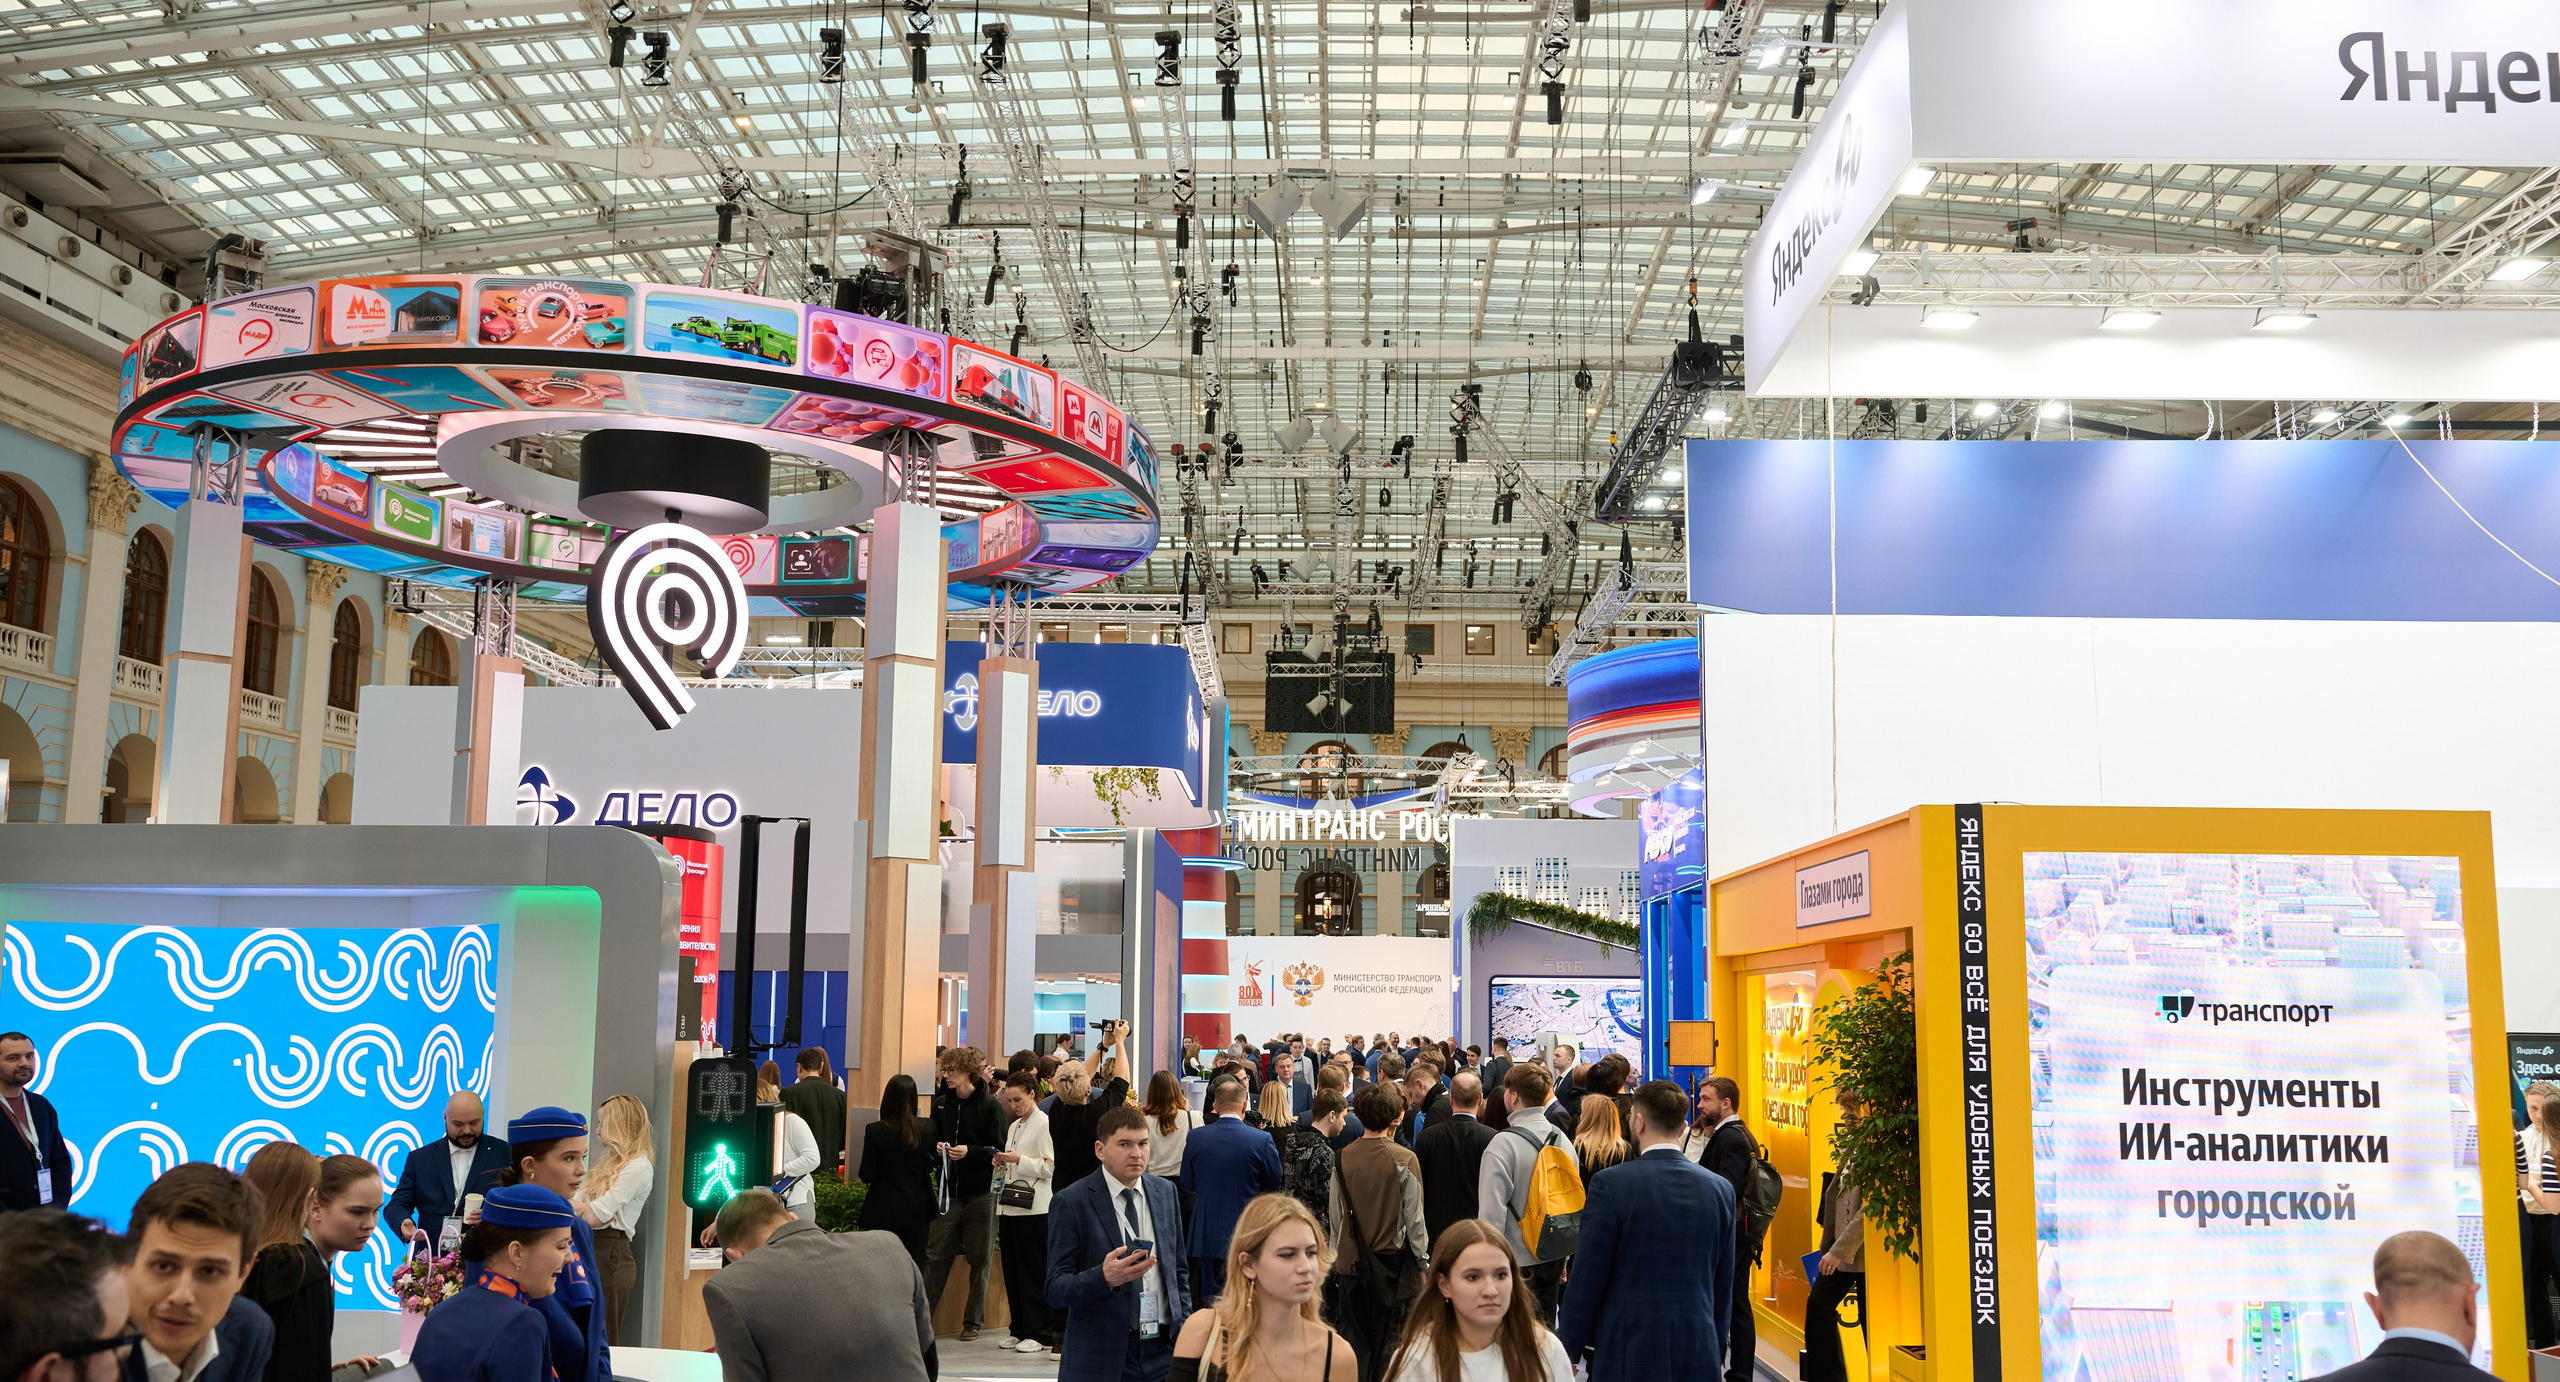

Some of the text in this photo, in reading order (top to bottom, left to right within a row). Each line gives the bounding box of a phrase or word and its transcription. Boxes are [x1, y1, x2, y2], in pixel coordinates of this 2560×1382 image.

[2338, 32, 2560, 113] Янде
[1772, 112, 1863, 307] Яндекс Go
[248, 301, 296, 314] Московская
[520, 281, 587, 311] Транспорта
[243, 330, 268, 340] МАДИ
[550, 312, 589, 348] Москвы
[1037, 691, 1101, 717] ЕЛО
[594, 792, 738, 827] ДЕЛО
[1238, 809, 1386, 842] МИНТРАНС
[1801, 872, 1863, 909] Глазами города
[680, 924, 701, 933] шения
[679, 941, 716, 951] авительства
[708, 973, 716, 984] РФ
[1333, 973, 1442, 983] МИНИСТЕРСТВО ТРАНСПОРТА
[1556, 960, 1583, 973] ВТБ
[1238, 985, 1251, 999] 80
[1333, 984, 1434, 995] РОССИЙСКОЙ ФЕДЕРАЦИИ
[1762, 1000, 1790, 1035] Яндекс
[2199, 1003, 2333, 1027] транспорт
[2516, 1046, 2554, 1056] Яндекс Go
[1788, 1054, 1807, 1092] удоб
[1960, 818, 1996, 1325] ЯНДЕКС GO ВСЁ ДЛЯ УДОБНЫХ ПОЕЗДОК
[2516, 1060, 2560, 1076] Здесь е
[2122, 1068, 2381, 1117] Инструменты
[2119, 1122, 2389, 1163] ИИ-аналитики
[2157, 1183, 2356, 1228] городской
